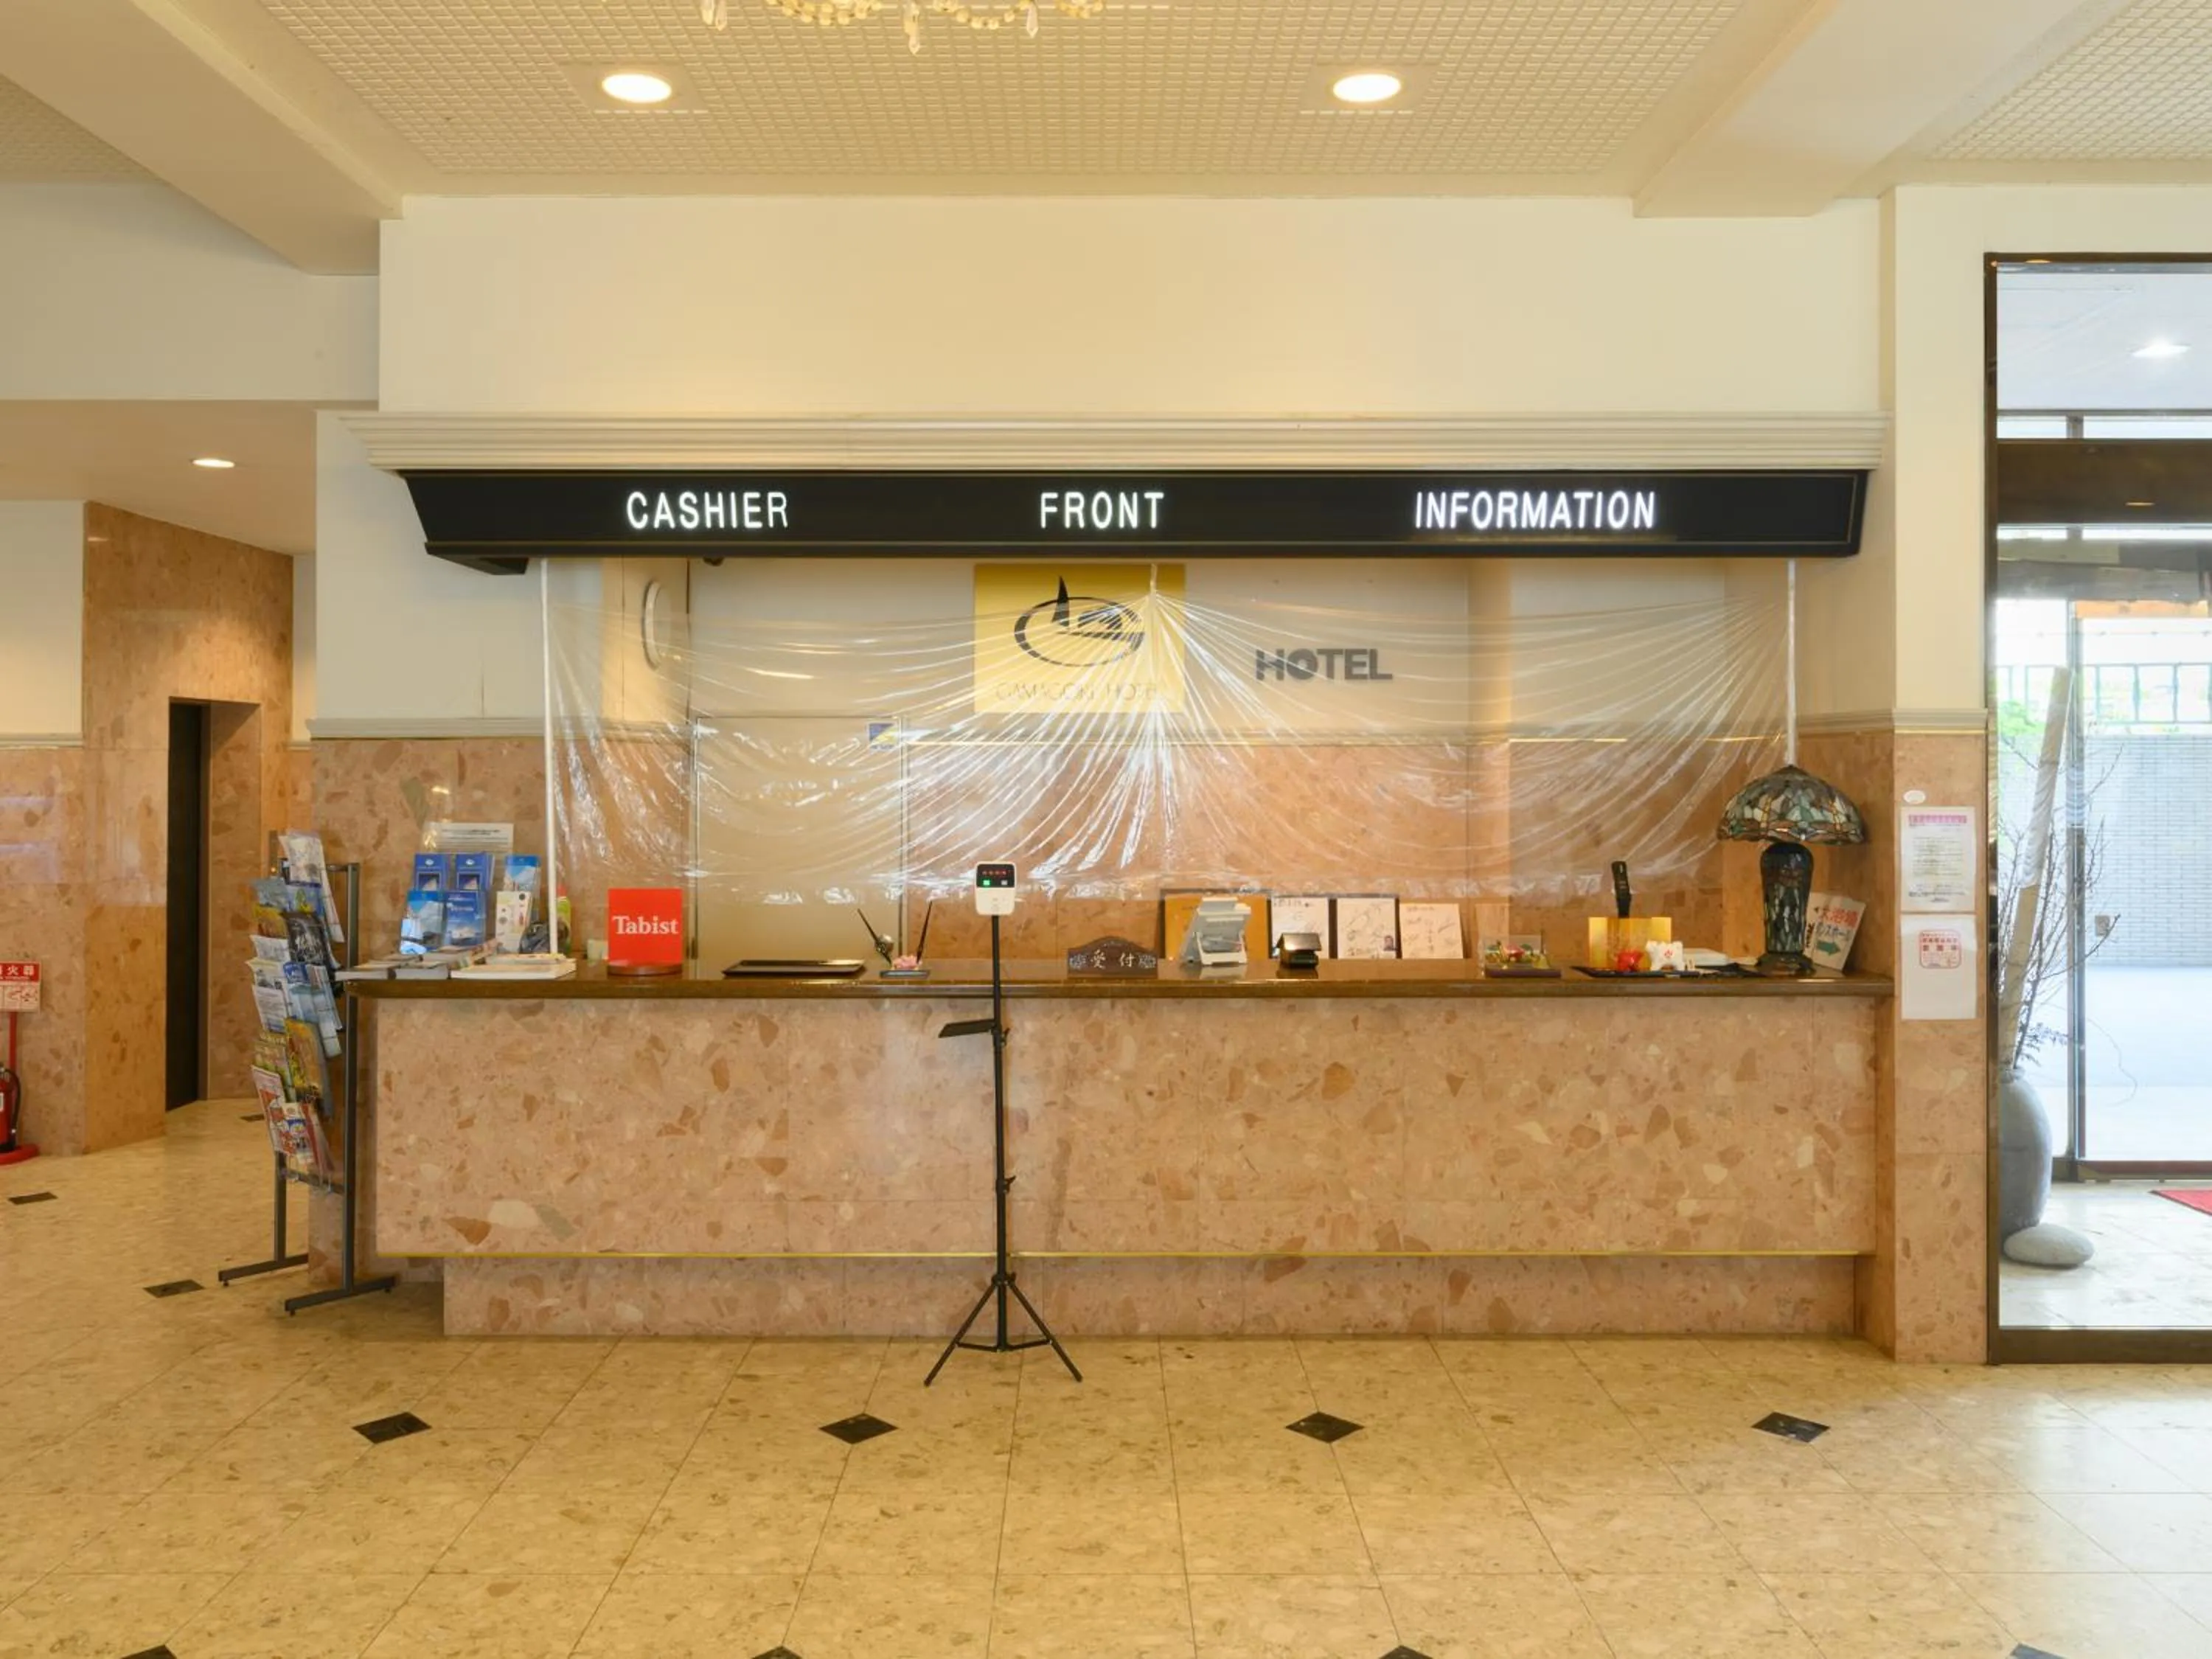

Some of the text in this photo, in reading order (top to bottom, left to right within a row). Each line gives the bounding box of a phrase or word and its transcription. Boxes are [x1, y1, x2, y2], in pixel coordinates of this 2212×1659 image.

[627, 491, 788, 529] CASHIER
[1040, 491, 1164, 529] FRONT
[1415, 491, 1655, 529] INFORMATION
[1256, 648, 1393, 681] HOTEL
[611, 915, 679, 934] Tabist
